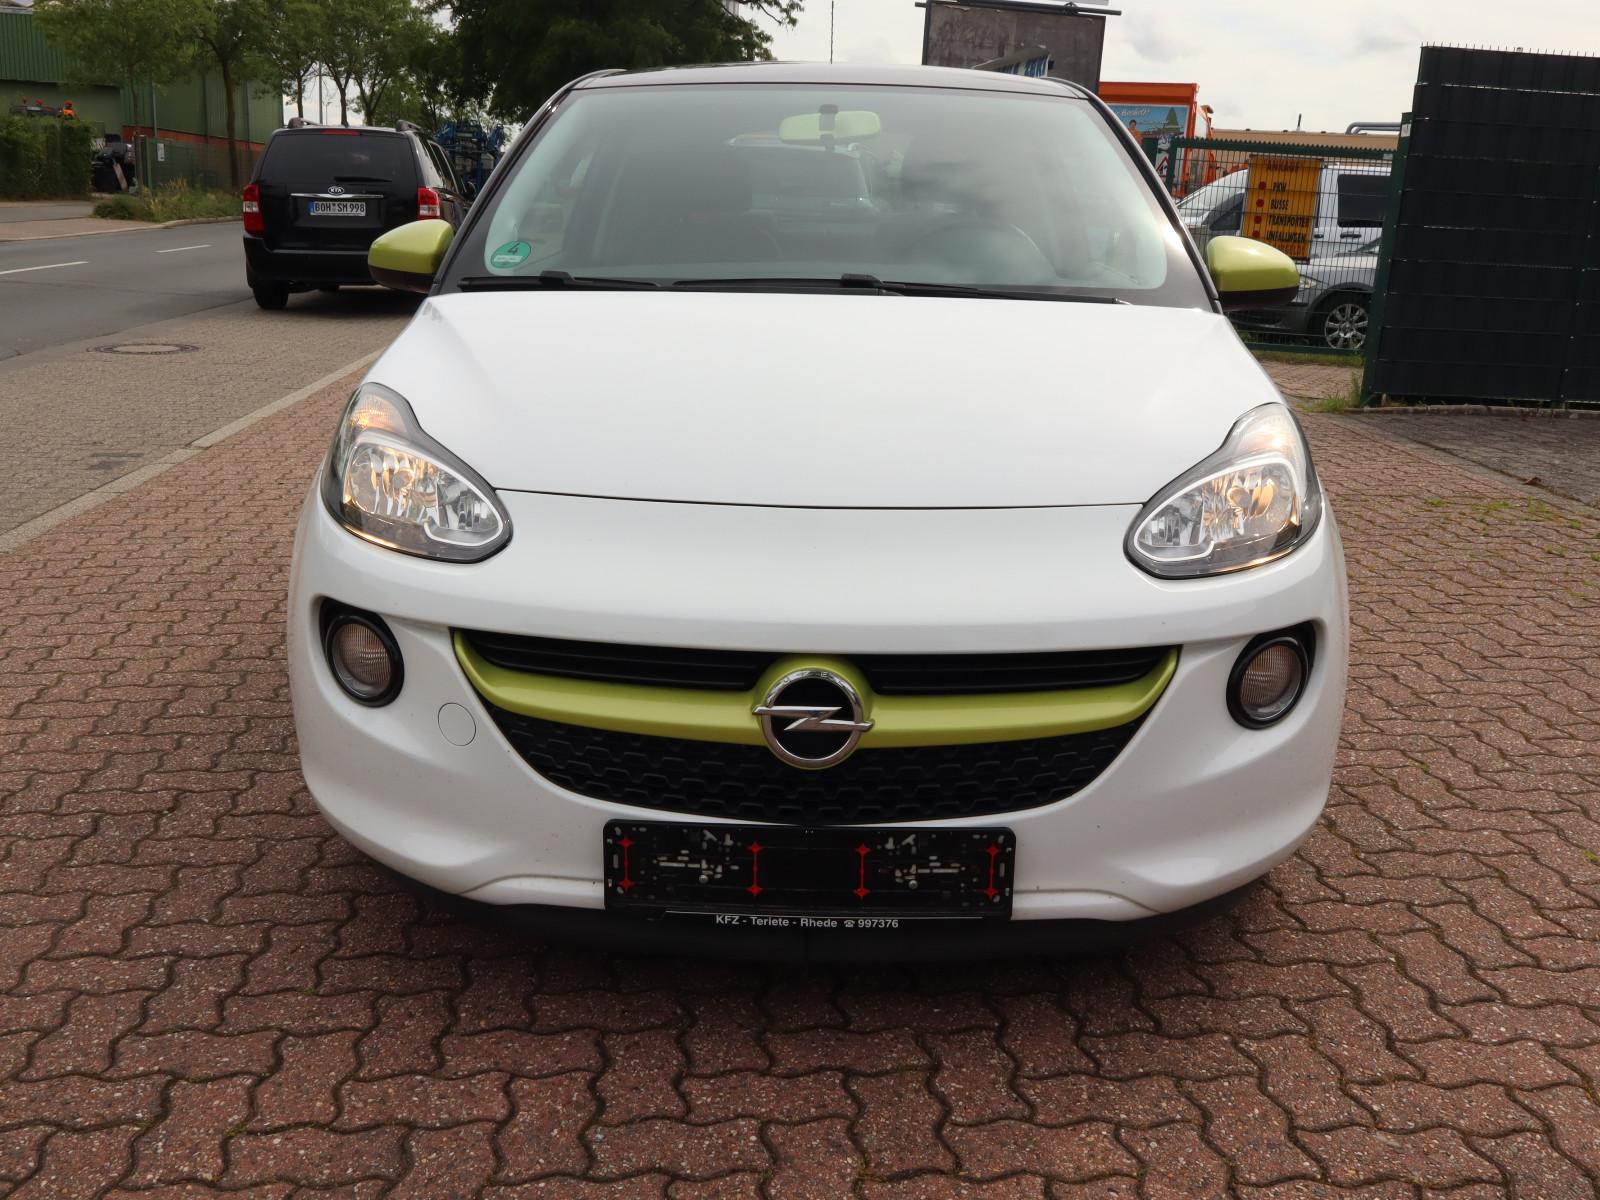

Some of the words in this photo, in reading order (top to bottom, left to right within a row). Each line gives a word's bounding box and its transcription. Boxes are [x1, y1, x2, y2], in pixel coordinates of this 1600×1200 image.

[315, 202, 331, 212] BOH
[349, 203, 365, 213] 998
[1270, 198, 1290, 210] BUSSE
[507, 242, 521, 255] 4
[715, 914, 740, 925] KFZ
[800, 918, 838, 928] Rhede
[857, 919, 899, 928] 997376
